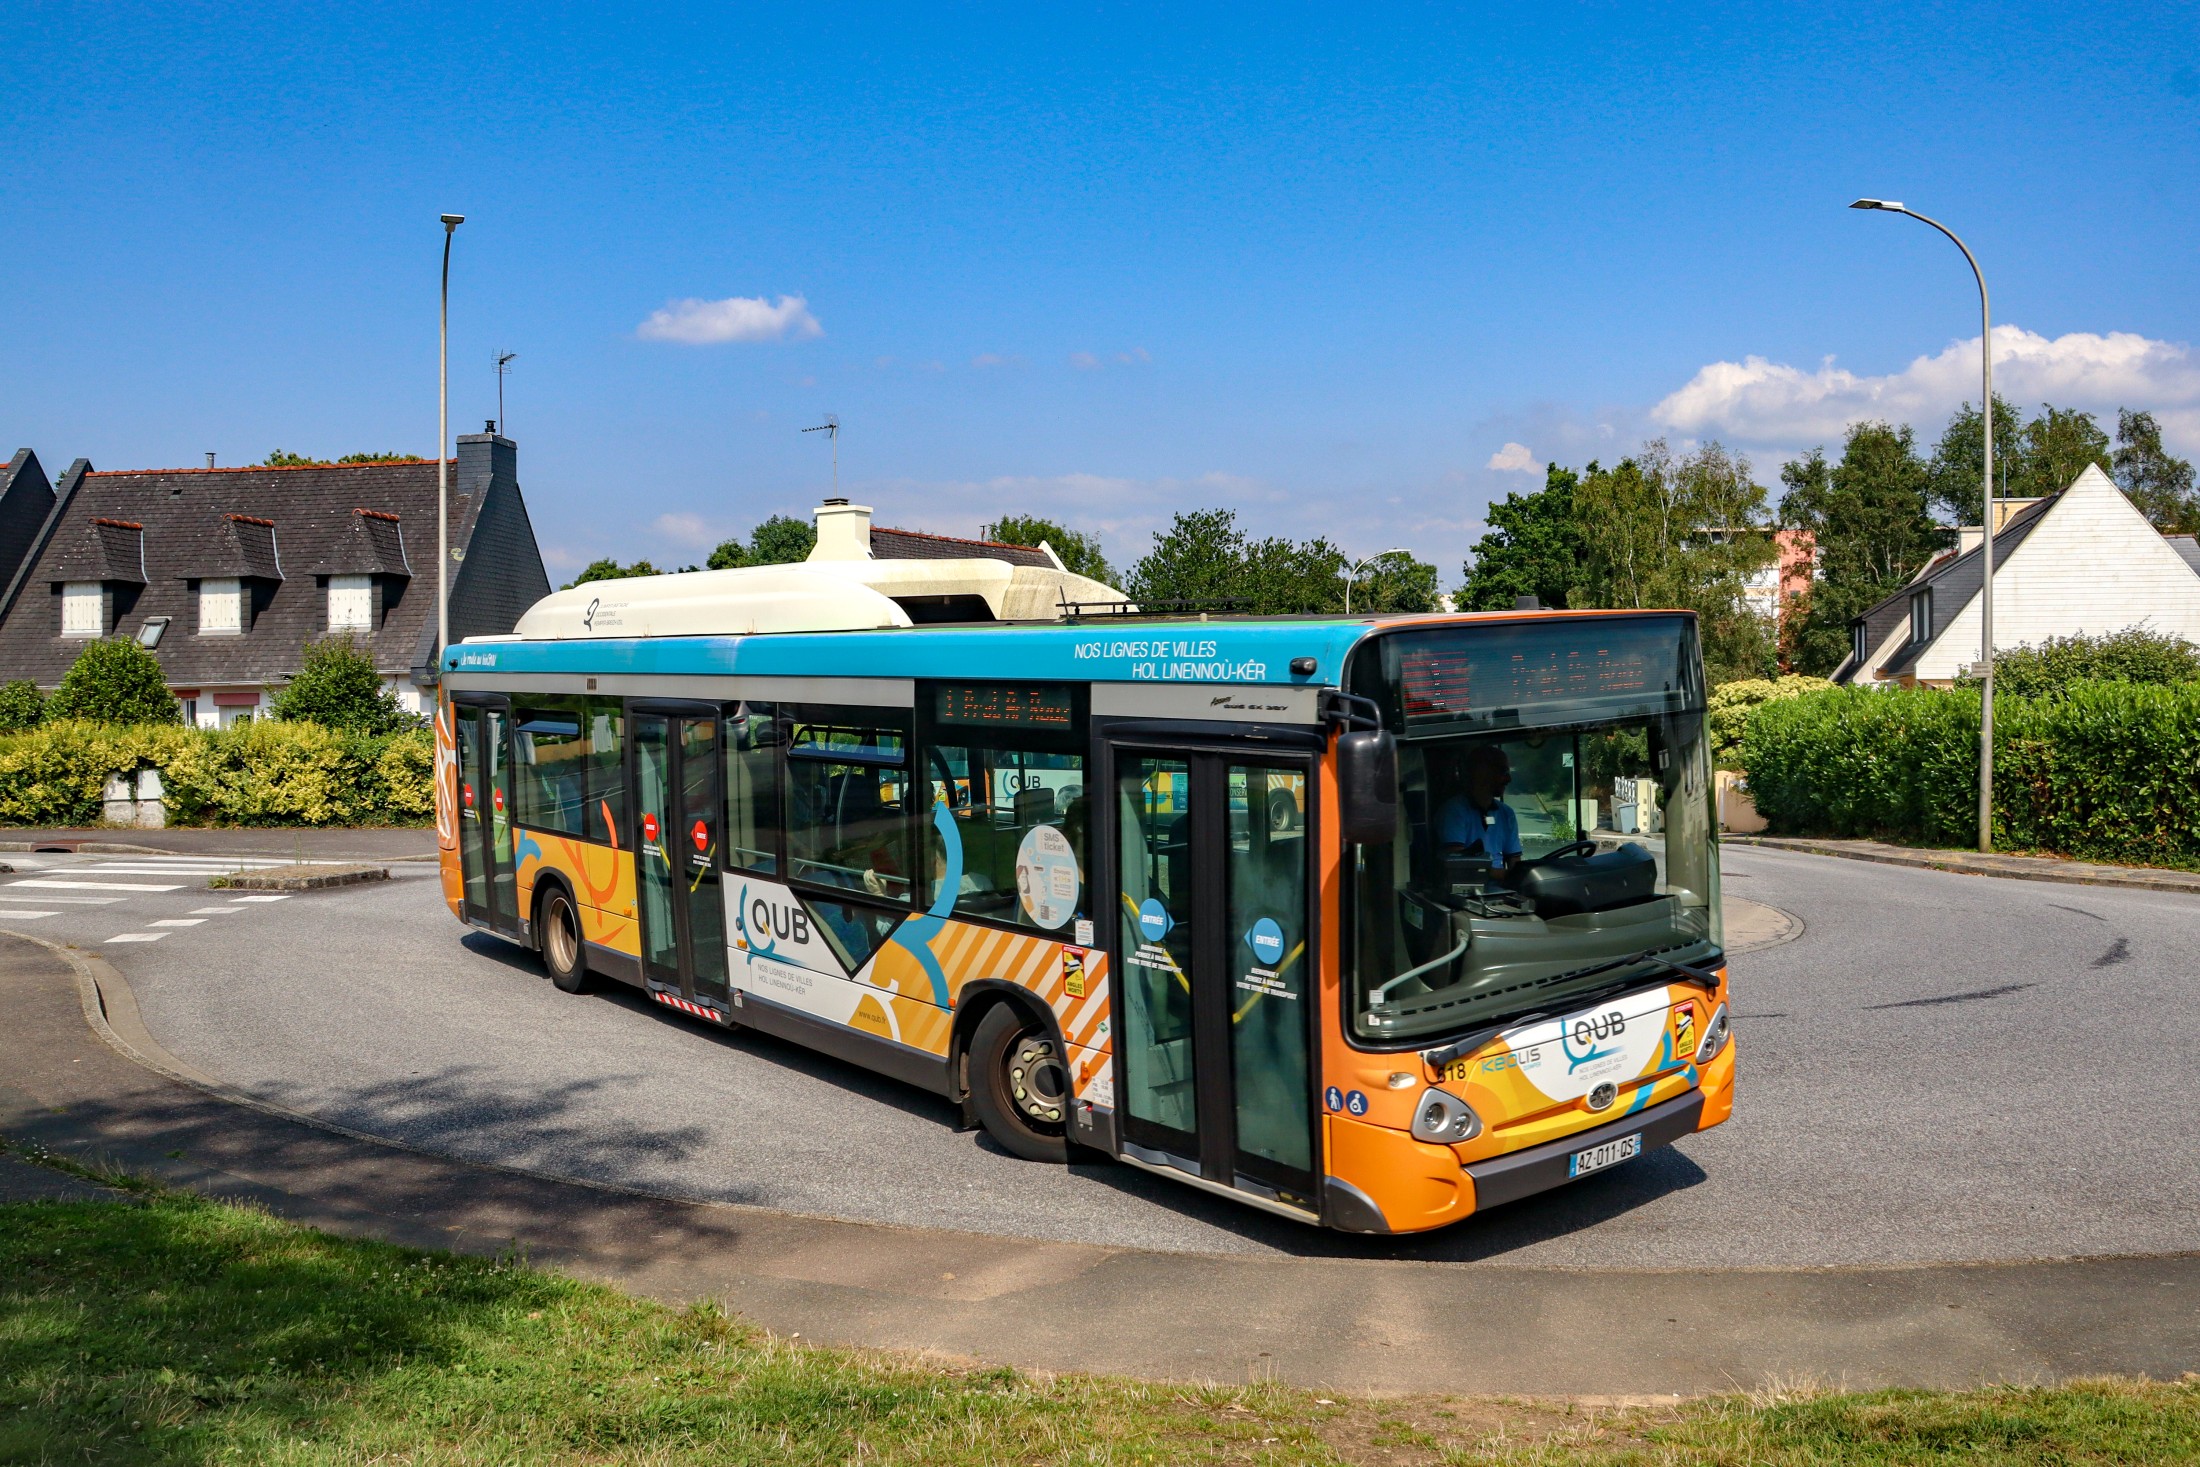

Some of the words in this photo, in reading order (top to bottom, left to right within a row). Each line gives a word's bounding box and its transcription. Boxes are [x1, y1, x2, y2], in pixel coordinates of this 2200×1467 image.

[1074, 643, 1101, 659] NOS
[1103, 642, 1148, 658] LIGNES
[1151, 642, 1170, 658] DE
[1173, 641, 1217, 658] VILLES
[1132, 662, 1159, 679] HOL
[1162, 659, 1266, 680] LINENNOÙ-KÊR
[1043, 832, 1060, 842] SMS
[1043, 842, 1065, 852] ticket
[752, 898, 810, 945] QUB
[1141, 914, 1164, 926] ENTRÉE
[1255, 934, 1280, 948] ENTRÉE
[1574, 1011, 1626, 1046] QUB
[1578, 1138, 1634, 1172] AZ-011-QS
